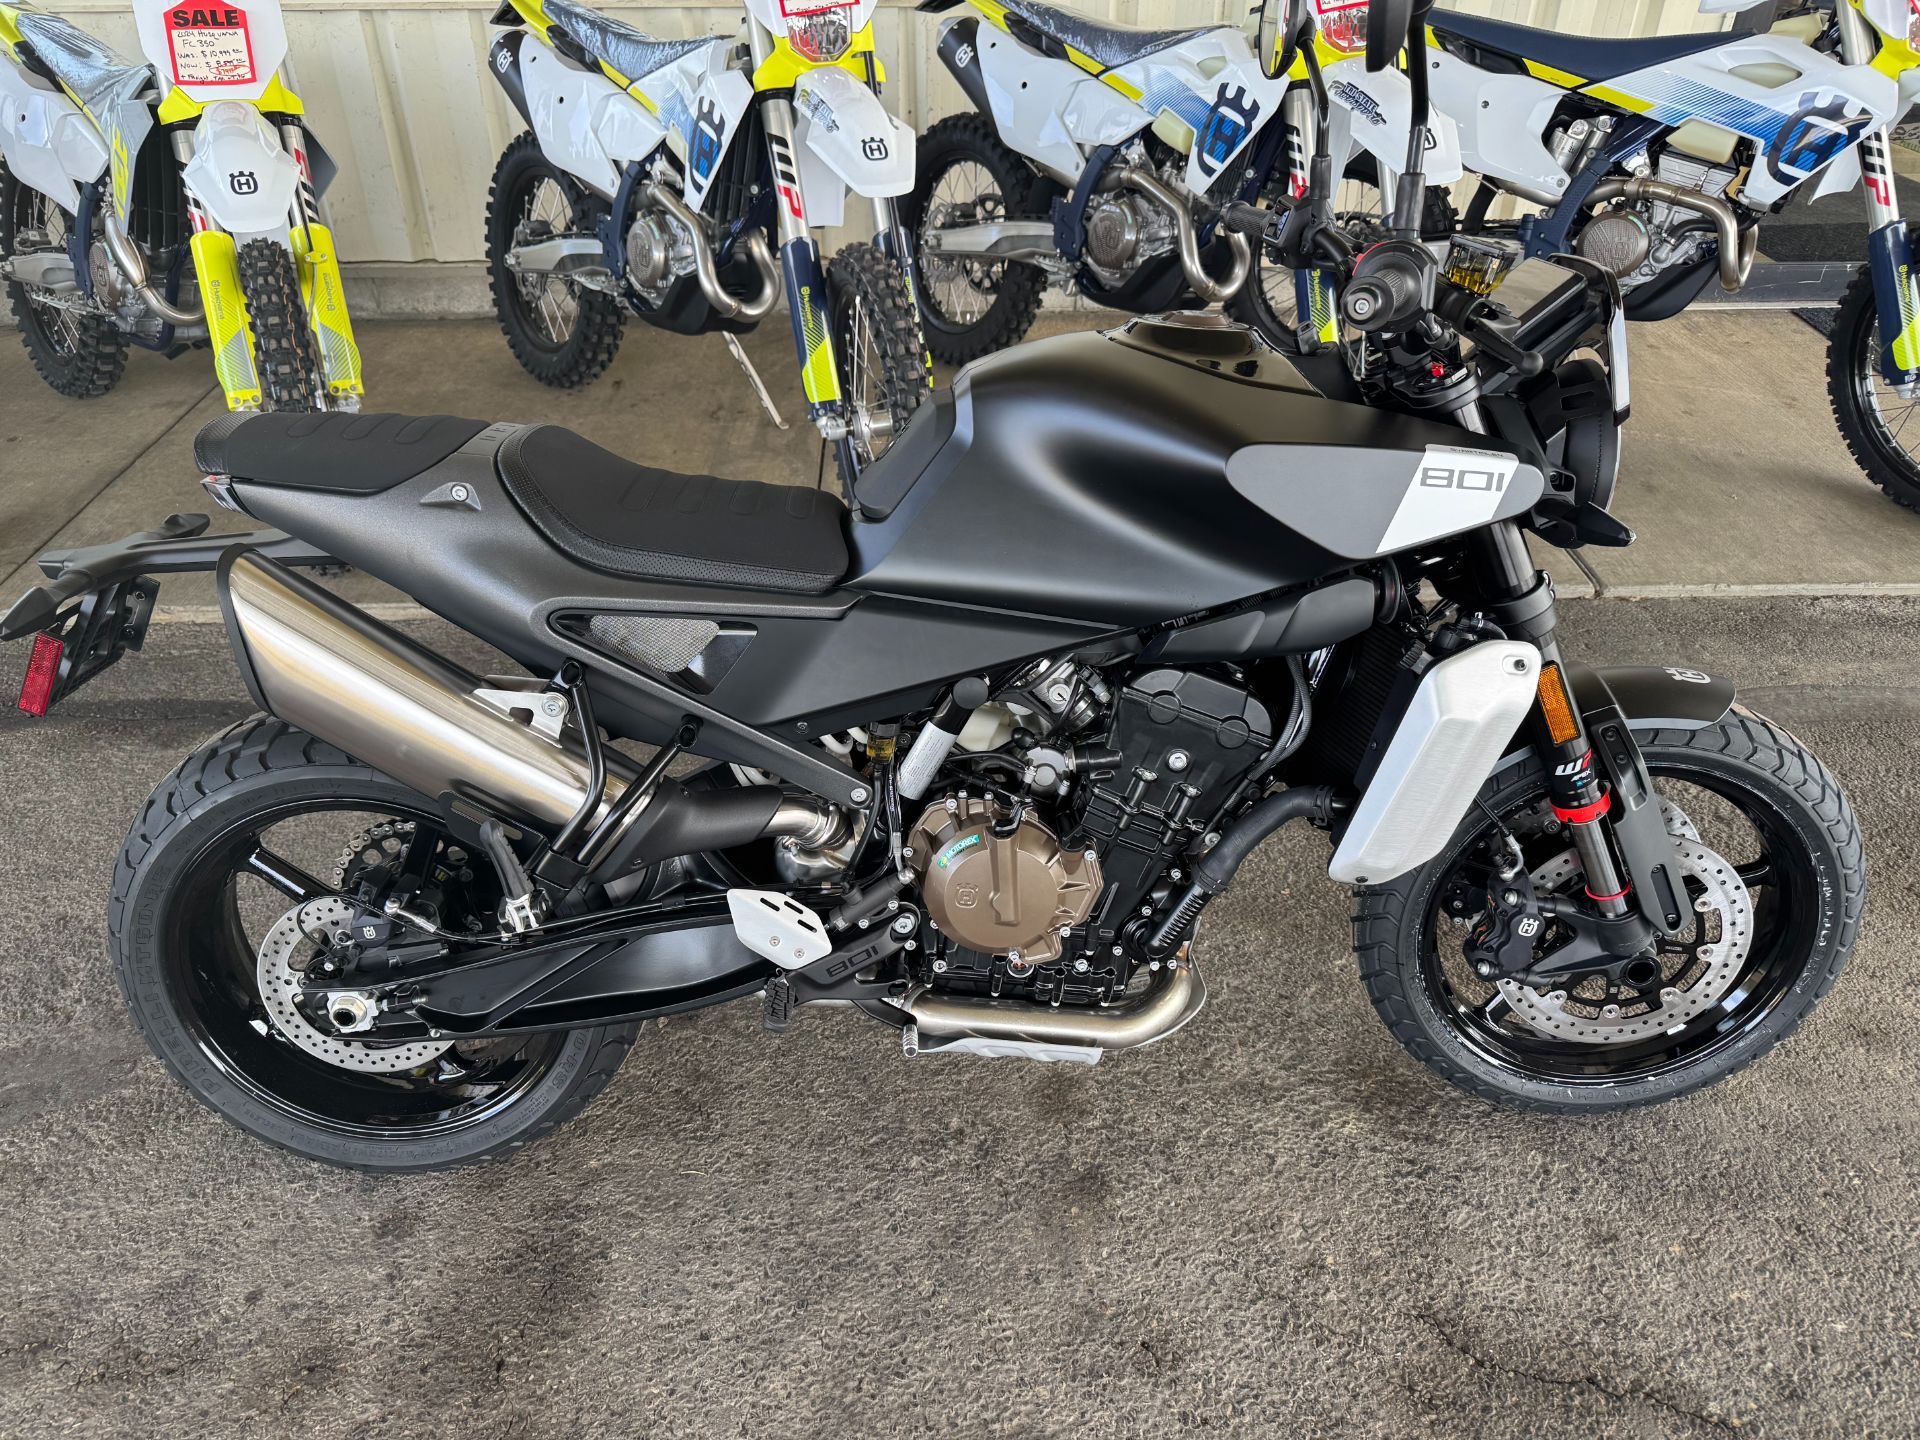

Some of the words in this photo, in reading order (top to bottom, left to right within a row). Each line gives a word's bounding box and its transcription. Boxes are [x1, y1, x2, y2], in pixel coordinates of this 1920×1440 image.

[172, 10, 240, 27] SALE
[198, 40, 215, 48] 350
[1420, 467, 1505, 492] 801
[945, 834, 978, 860] MOTOREX
[826, 945, 879, 978] 801
